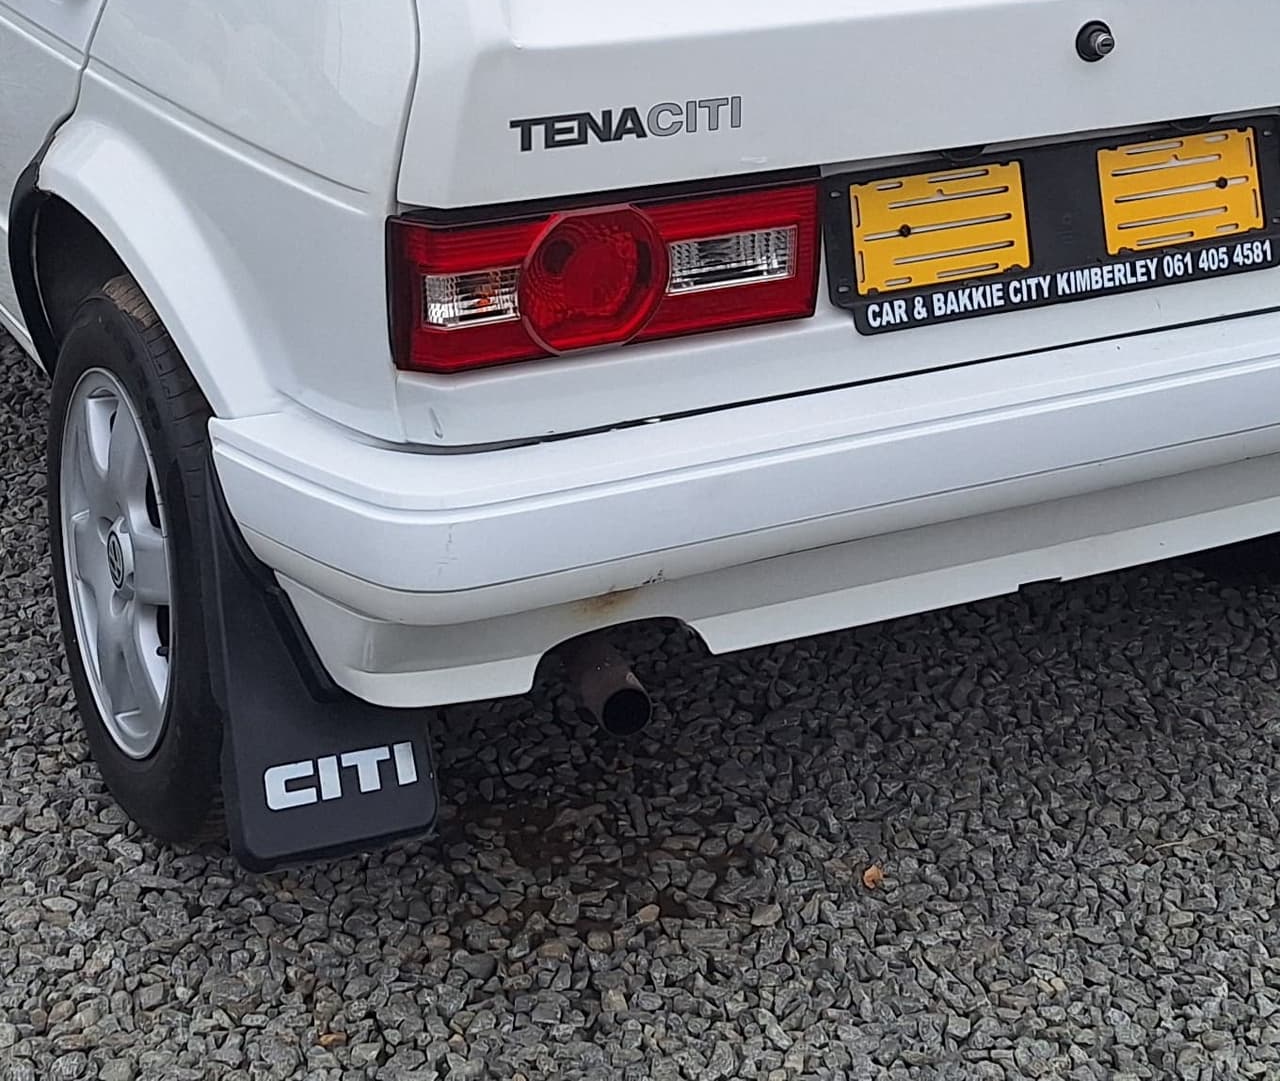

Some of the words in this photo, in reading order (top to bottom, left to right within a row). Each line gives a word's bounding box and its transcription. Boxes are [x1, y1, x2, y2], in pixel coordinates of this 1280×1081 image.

[509, 96, 742, 153] TENACITI
[867, 299, 908, 328] CAR
[913, 296, 928, 320] &
[932, 283, 1005, 317] BAKKIE
[1008, 275, 1052, 304] CITY
[1057, 257, 1159, 296] KIMBERLEY
[1163, 252, 1193, 278] 061
[1198, 246, 1229, 272] 405
[1233, 239, 1273, 266] 4581
[263, 741, 418, 811] CITI
